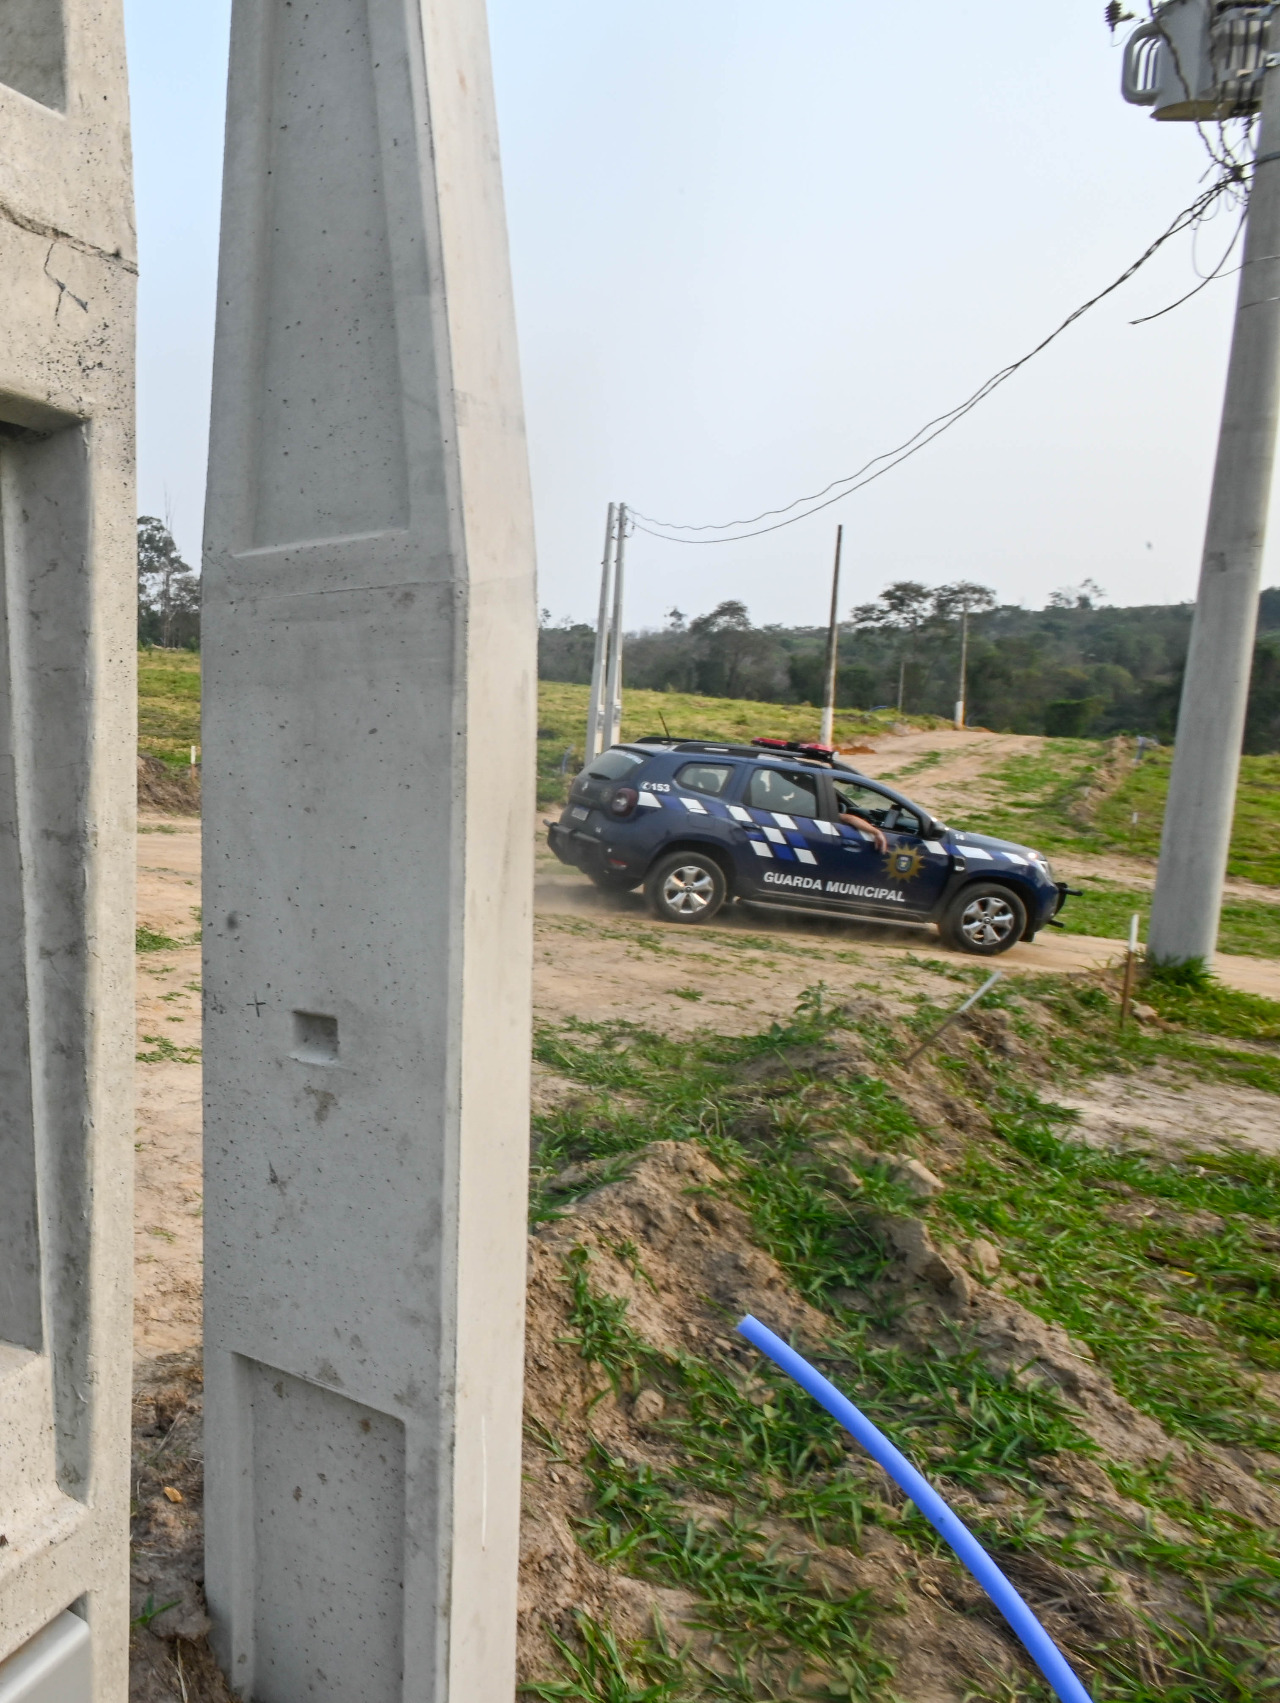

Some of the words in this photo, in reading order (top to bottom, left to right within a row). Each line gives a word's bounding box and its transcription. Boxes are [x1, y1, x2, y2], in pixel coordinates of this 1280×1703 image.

[650, 783, 671, 792] 153
[763, 871, 823, 891] GUARDA
[826, 881, 906, 902] MUNICIPAL
